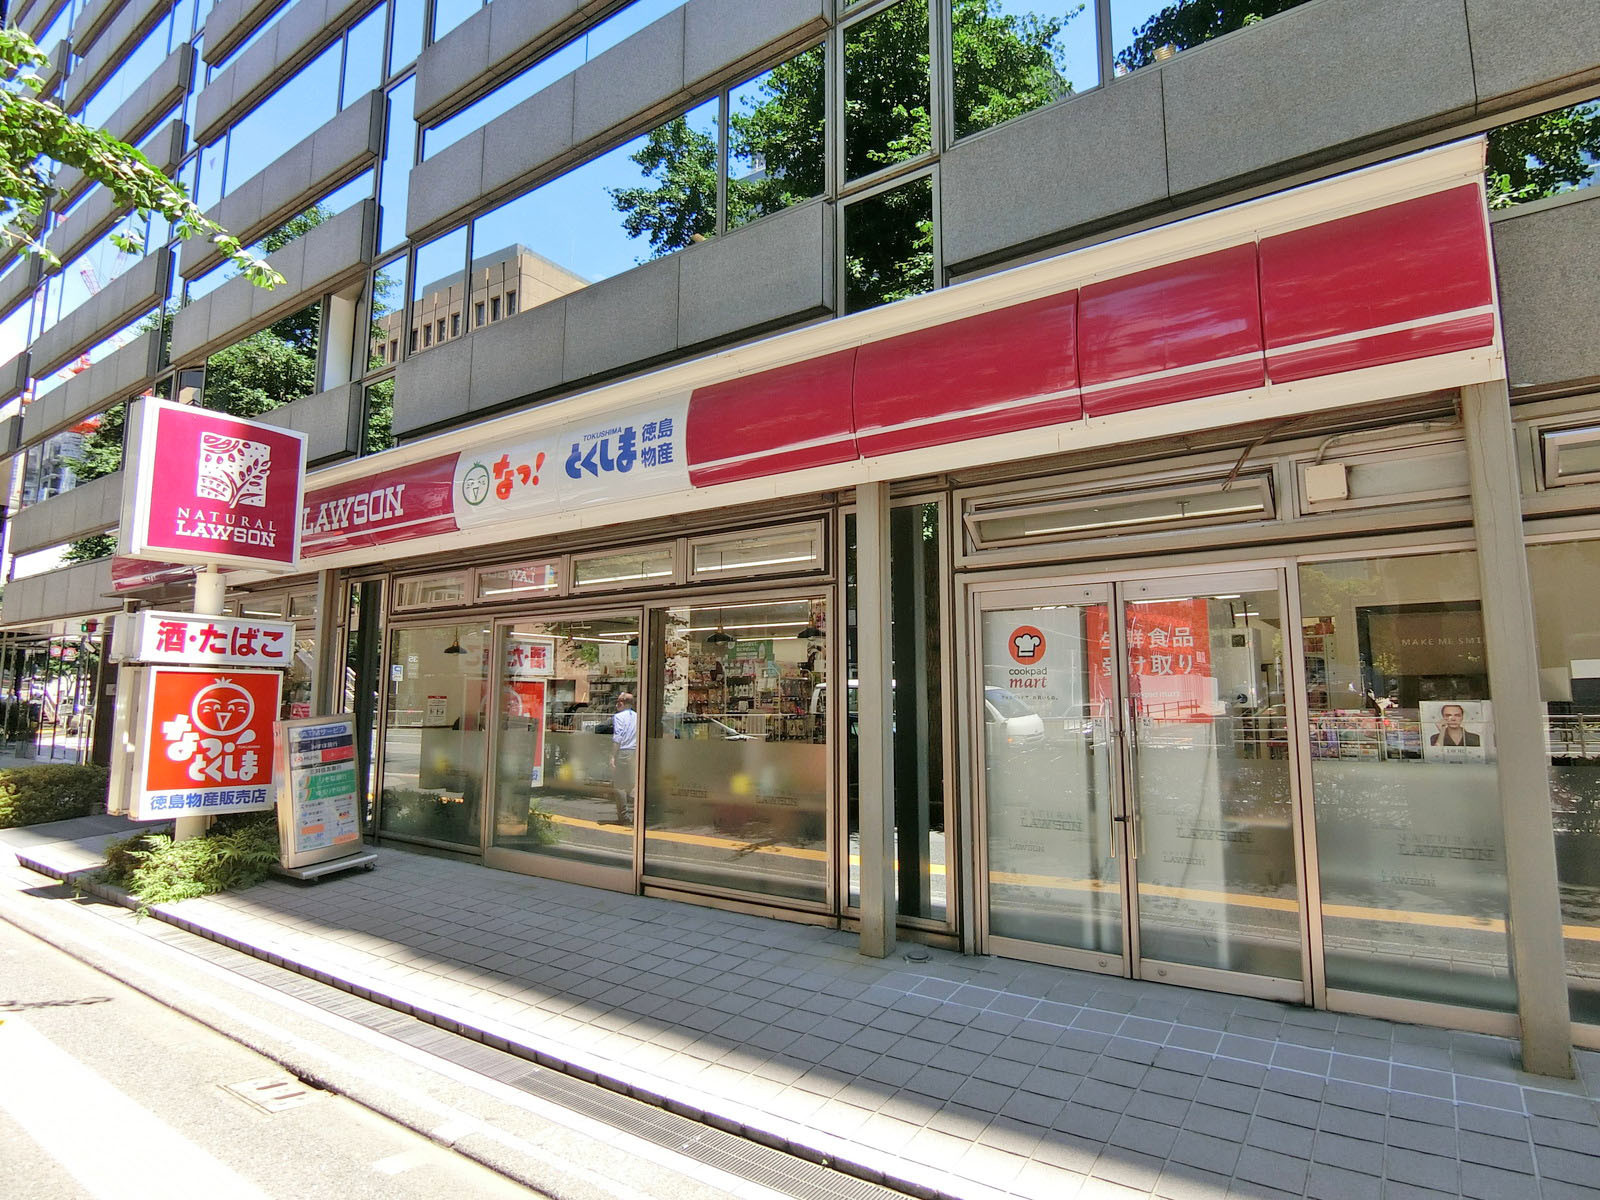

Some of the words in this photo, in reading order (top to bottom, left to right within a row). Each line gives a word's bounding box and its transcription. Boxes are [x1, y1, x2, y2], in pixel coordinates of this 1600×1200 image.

[583, 426, 623, 442] TOKUSHIMA
[641, 418, 674, 443] 徳島
[565, 426, 638, 480] とくしま
[641, 442, 674, 469] 物産
[177, 507, 277, 531] NATURAL
[301, 484, 406, 535] LAWSON
[175, 520, 276, 547] LAWSON
[156, 621, 284, 658] 酒・たばこ
[1401, 638, 1435, 647] MAKE
[1008, 666, 1048, 677] cookpad
[1009, 676, 1048, 689] mart
[189, 750, 258, 782] とくしま
[150, 788, 268, 811] 徳島物産販売店
[1019, 817, 1084, 832] LAWSON
